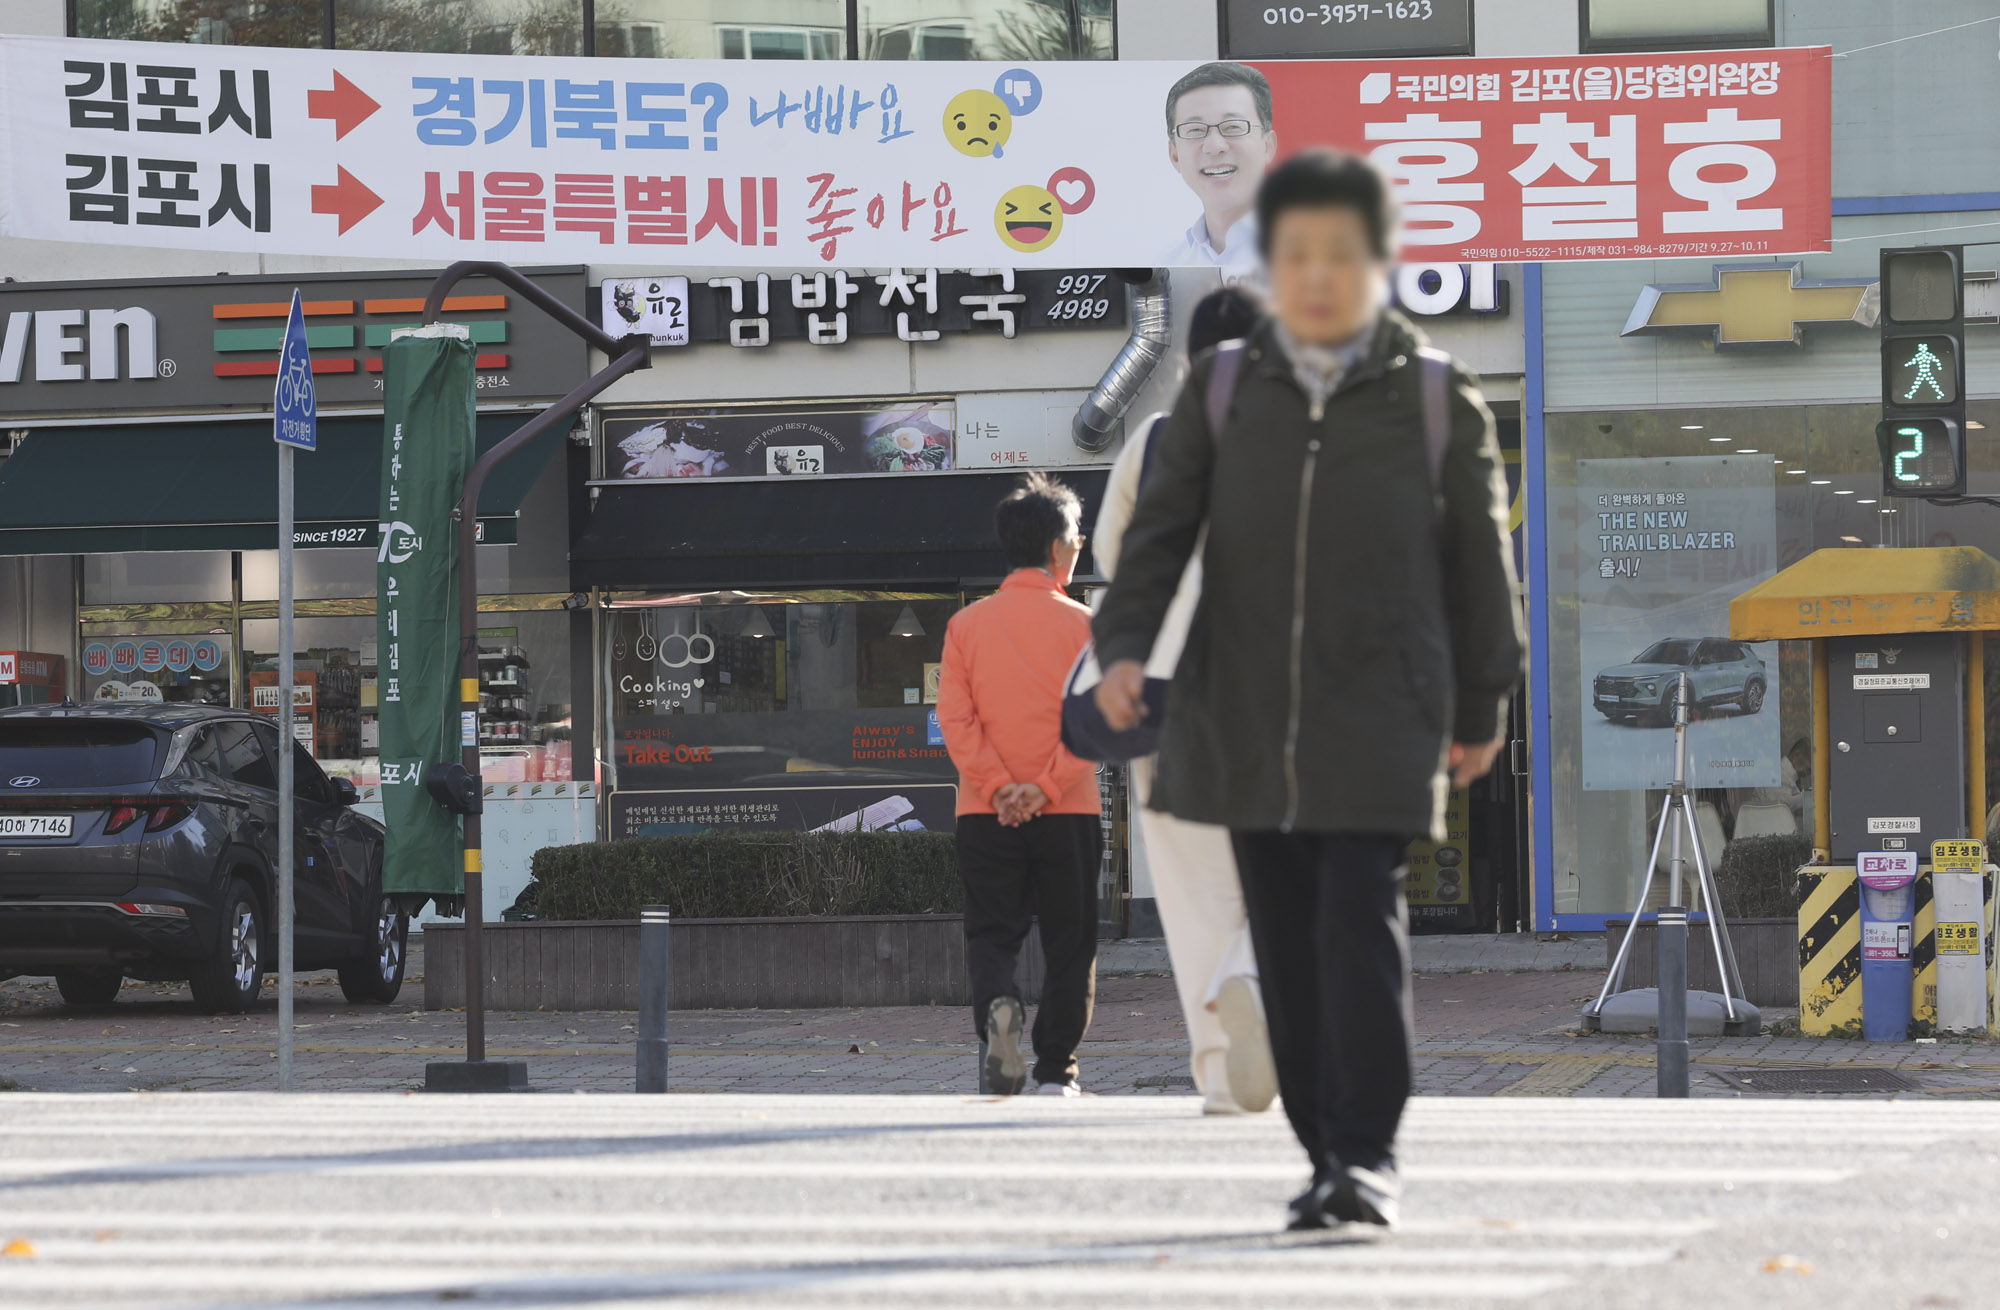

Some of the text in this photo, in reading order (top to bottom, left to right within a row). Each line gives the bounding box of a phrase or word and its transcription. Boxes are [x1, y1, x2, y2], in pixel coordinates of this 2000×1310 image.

[1263, 0, 1433, 25] 010-3957-1623
[1396, 61, 1782, 102] 국민의힘 김포(을)당협위원장
[64, 60, 914, 151] 김포시 경기북도? 나빠요
[1362, 107, 1784, 247] 홍철호
[65, 153, 968, 262] 김포시 서울특별시! 좋아요
[1460, 241, 1769, 258] 국민의힘 010-5522-1115/제작 031-984-8279/기간 9.27~10.11
[1056, 274, 1107, 295] 997
[707, 267, 1027, 348] 김밥천국
[1047, 299, 1110, 320] 4989
[650, 333, 684, 342] hunkuk
[282, 418, 311, 442] 자전거횡단
[966, 421, 1000, 439] 나는
[745, 436, 762, 455] BEST
[762, 425, 784, 438] FOOD
[809, 425, 845, 453] DELICIOUS
[991, 451, 1029, 464] 어제도
[1895, 428, 1924, 482] 2
[389, 423, 403, 511] 통하는
[1599, 492, 1686, 506] 더 완벽하게 돌아온
[1599, 511, 1688, 530] THE NEW
[293, 529, 366, 543] SINCE 1927
[1598, 531, 1736, 552] TRAILBLAZER
[1599, 557, 1641, 578] 출시!
[87, 646, 214, 668] 빼빼로데이
[620, 675, 691, 699] Cooking
[638, 699, 671, 710] 스페셜
[853, 725, 916, 736] Alway's
[852, 738, 897, 748] ENJOY
[624, 744, 713, 764] Take Out
[625, 803, 781, 815] 매일매일 신선한 재료와 철저한 위생관리로
[30, 818, 67, 833] 7146
[625, 813, 777, 825] 최소 비용으로 최대 만족을 드릴 수 있도록
[1872, 821, 1916, 830] 김포경찰서장
[1448, 831, 1468, 840] 고기
[1935, 845, 1981, 857] 김포생활
[1864, 857, 1908, 872] 교차로
